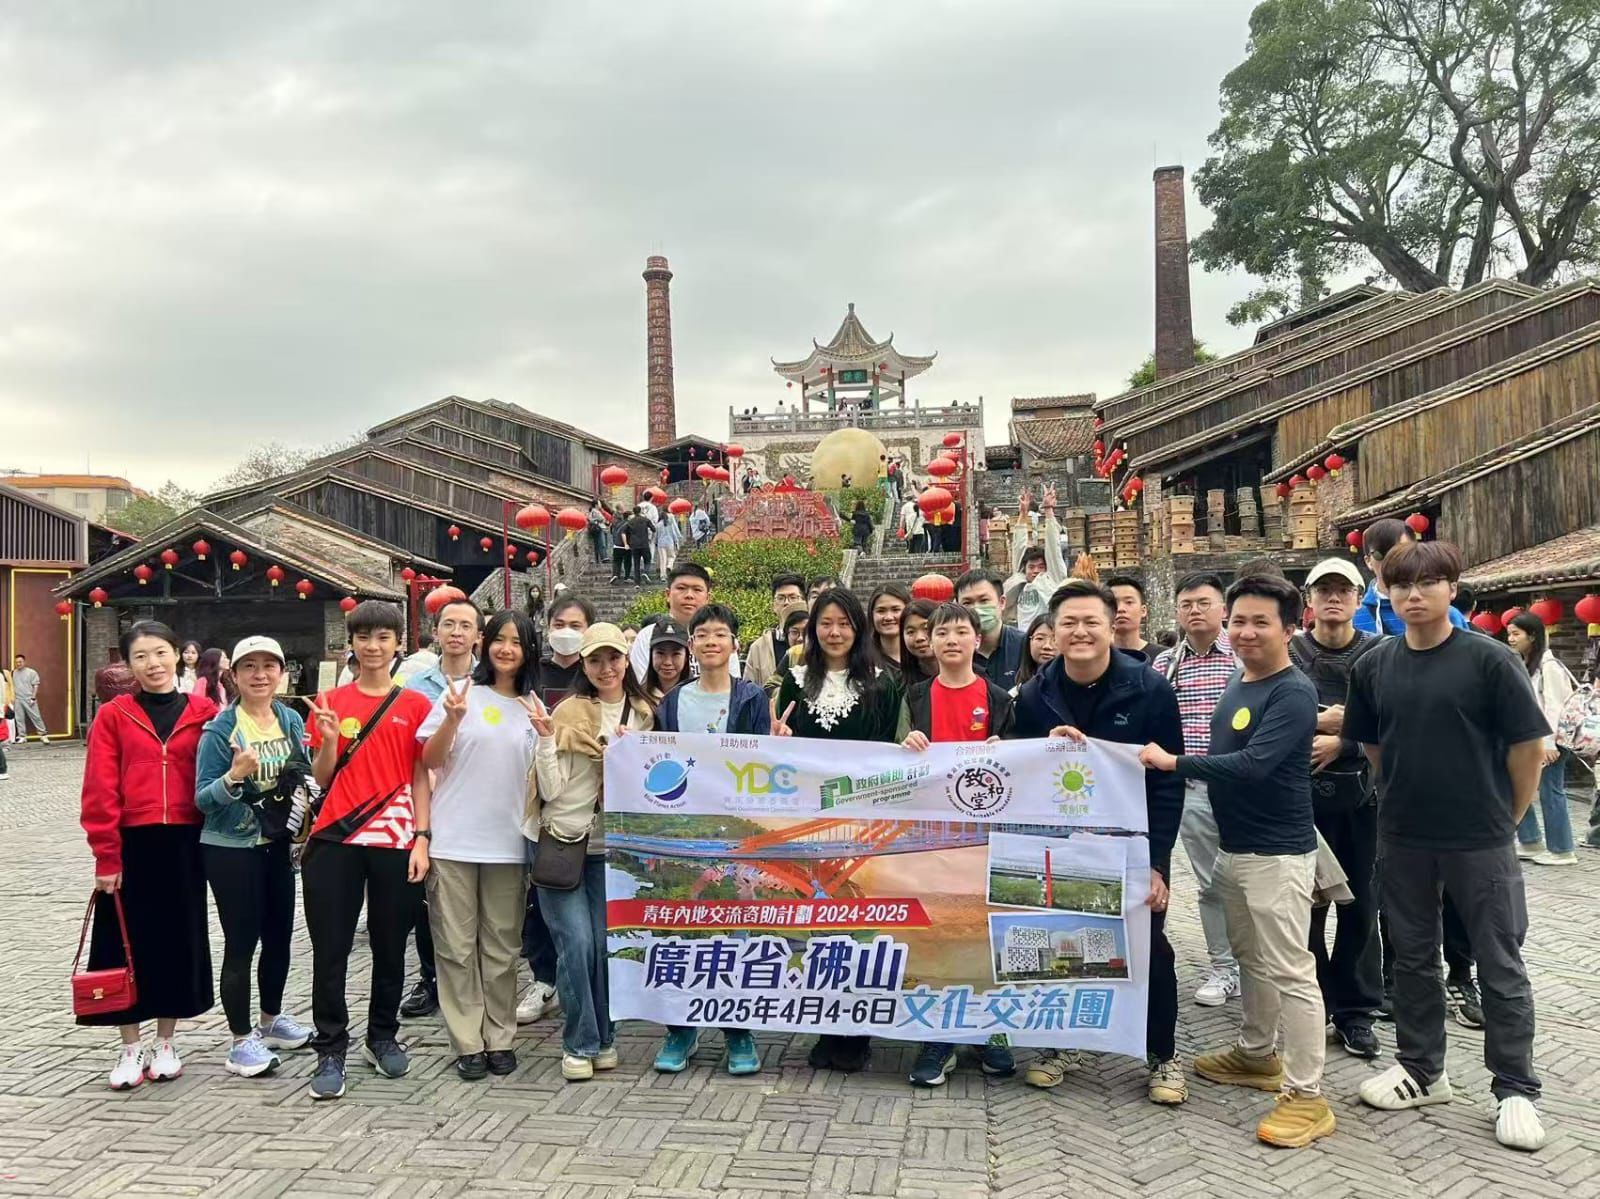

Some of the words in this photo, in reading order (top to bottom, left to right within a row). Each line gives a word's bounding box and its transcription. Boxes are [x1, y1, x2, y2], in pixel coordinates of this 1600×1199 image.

[724, 760, 799, 794] YDC
[835, 781, 918, 806] Government-sponsored
[872, 790, 911, 806] programme
[816, 904, 909, 922] 2024-2025
[686, 996, 898, 1025] 2025年4月4-6日
[896, 988, 1115, 1030] 文化交流團
